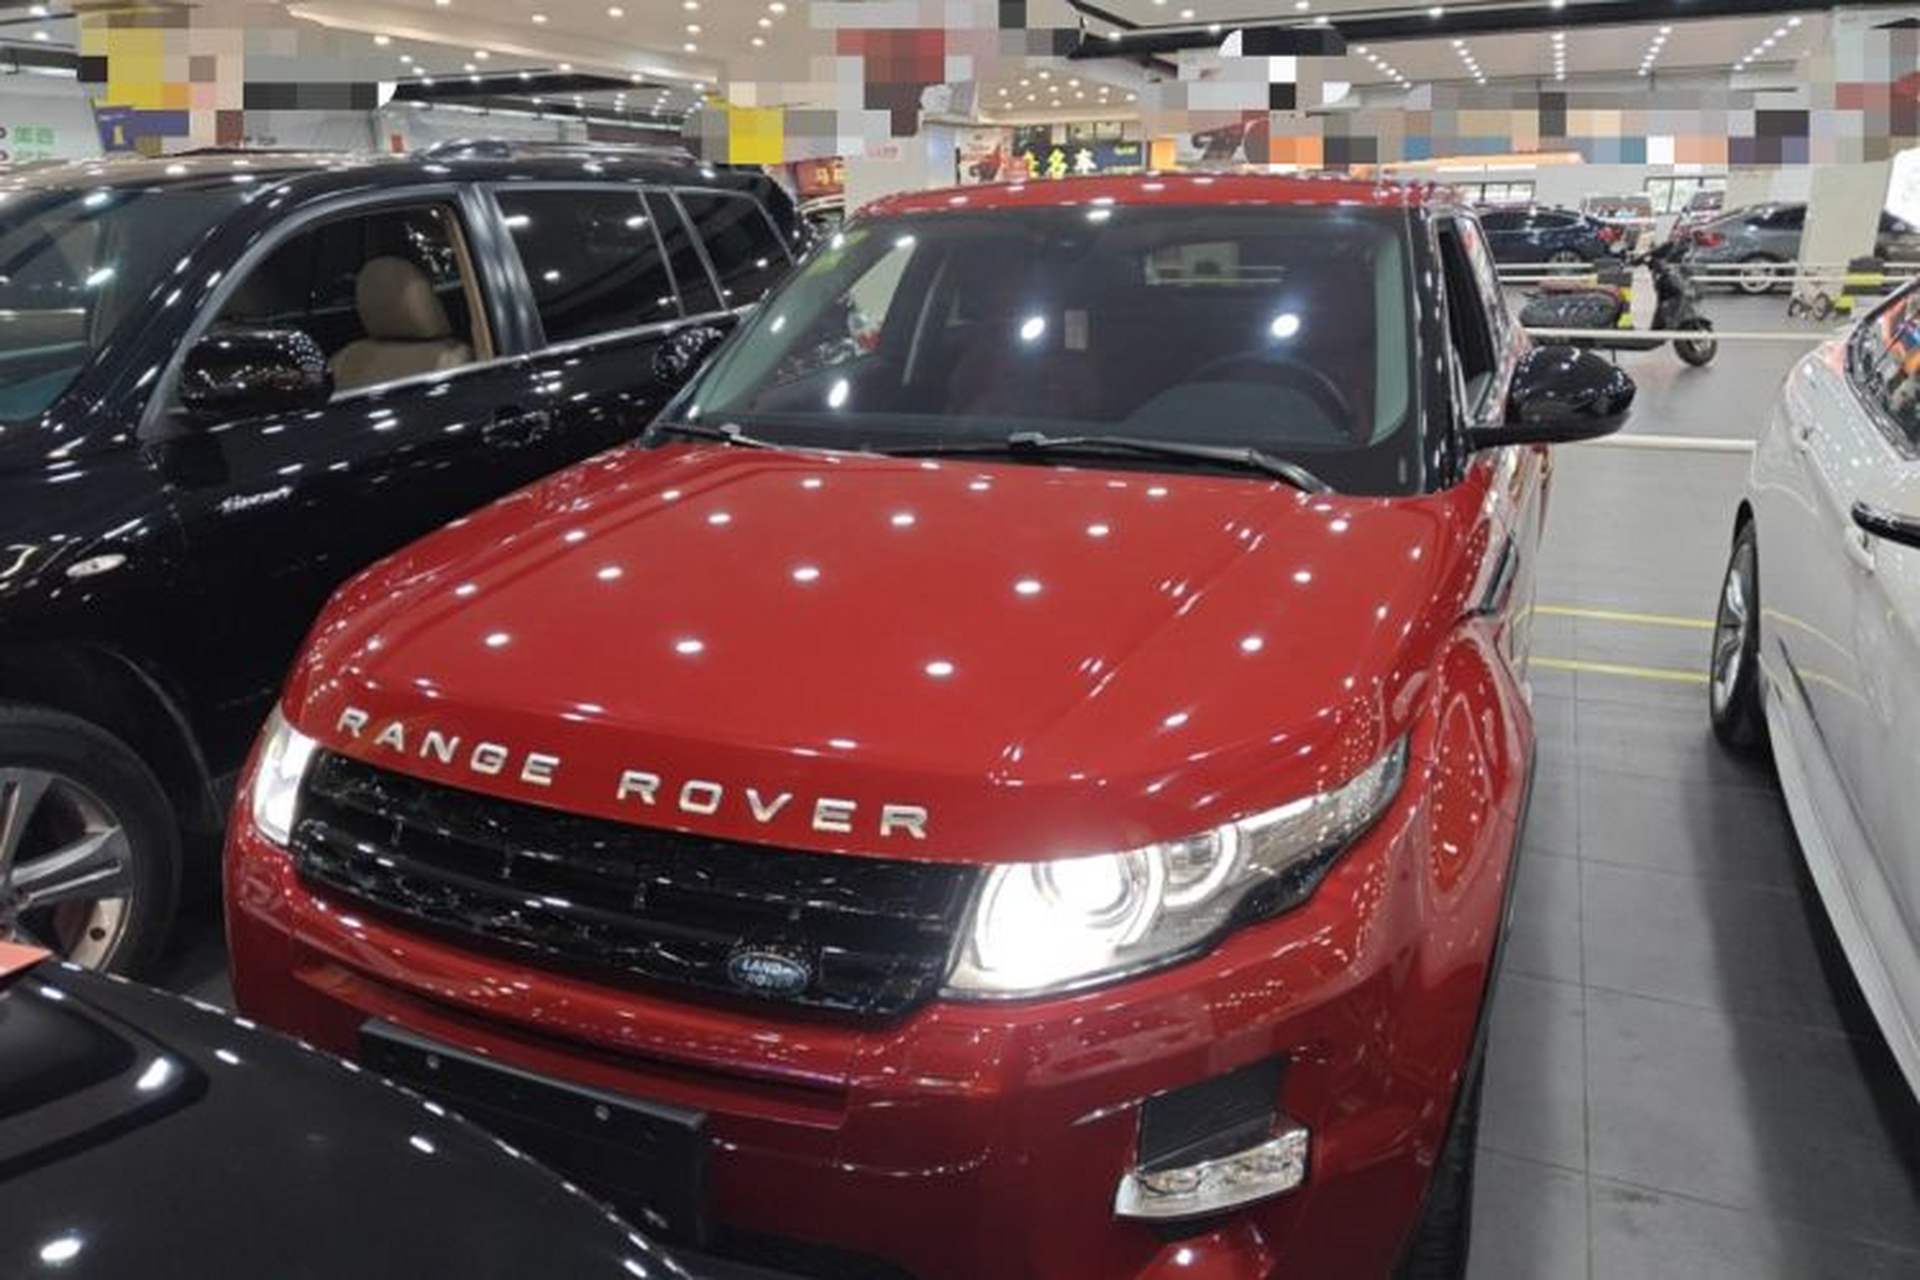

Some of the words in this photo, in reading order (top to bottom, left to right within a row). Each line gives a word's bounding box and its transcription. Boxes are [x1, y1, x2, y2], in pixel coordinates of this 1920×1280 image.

[335, 706, 561, 786] RANGE
[615, 769, 929, 839] ROVER
[741, 958, 783, 976] LAND
